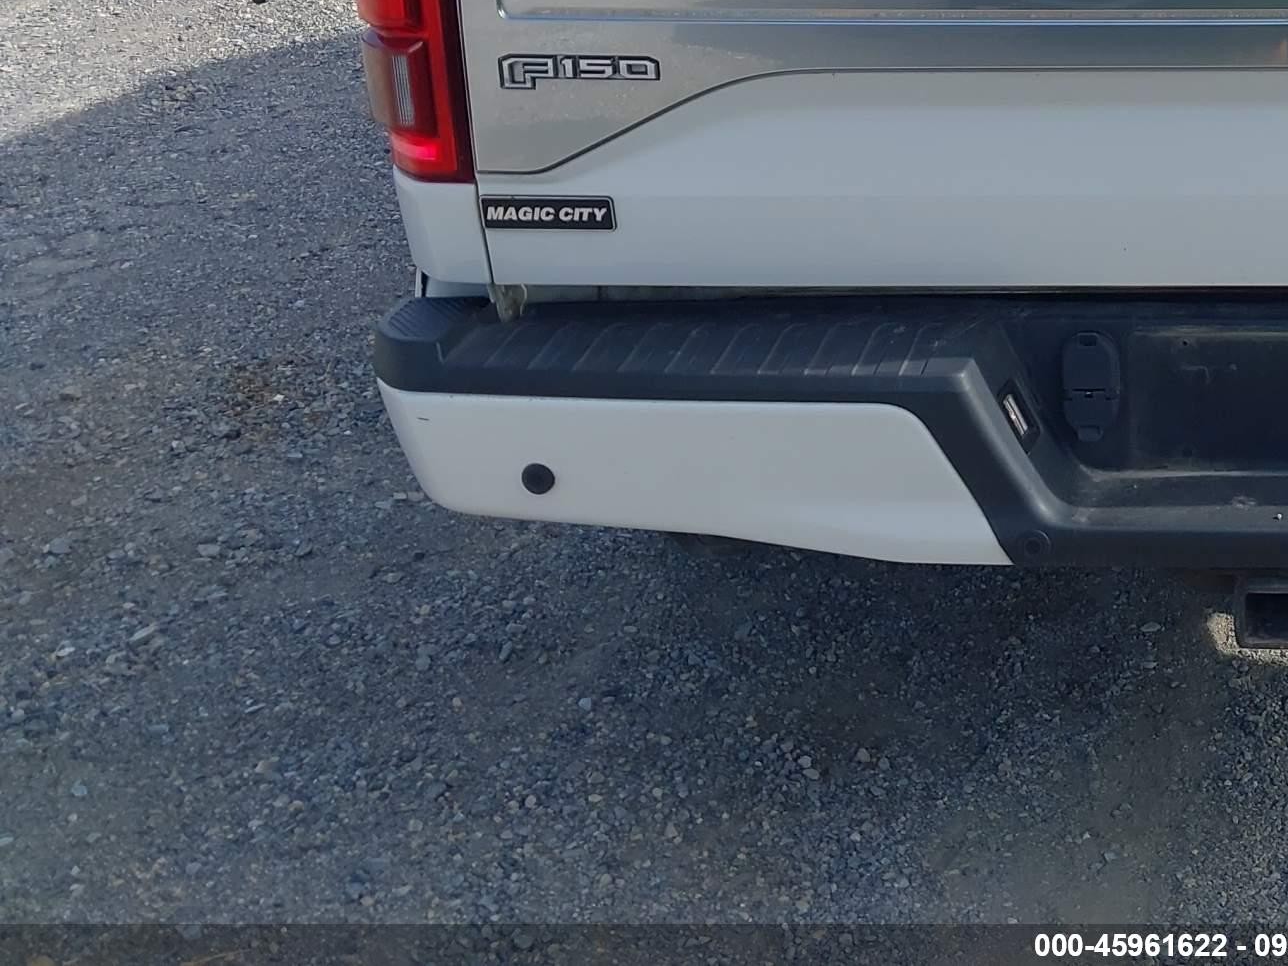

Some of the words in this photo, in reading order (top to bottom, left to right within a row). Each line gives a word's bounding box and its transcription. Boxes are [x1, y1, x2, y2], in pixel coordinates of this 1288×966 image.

[499, 54, 660, 90] F150
[486, 206, 556, 222] MAGIC
[558, 207, 608, 222] CITY
